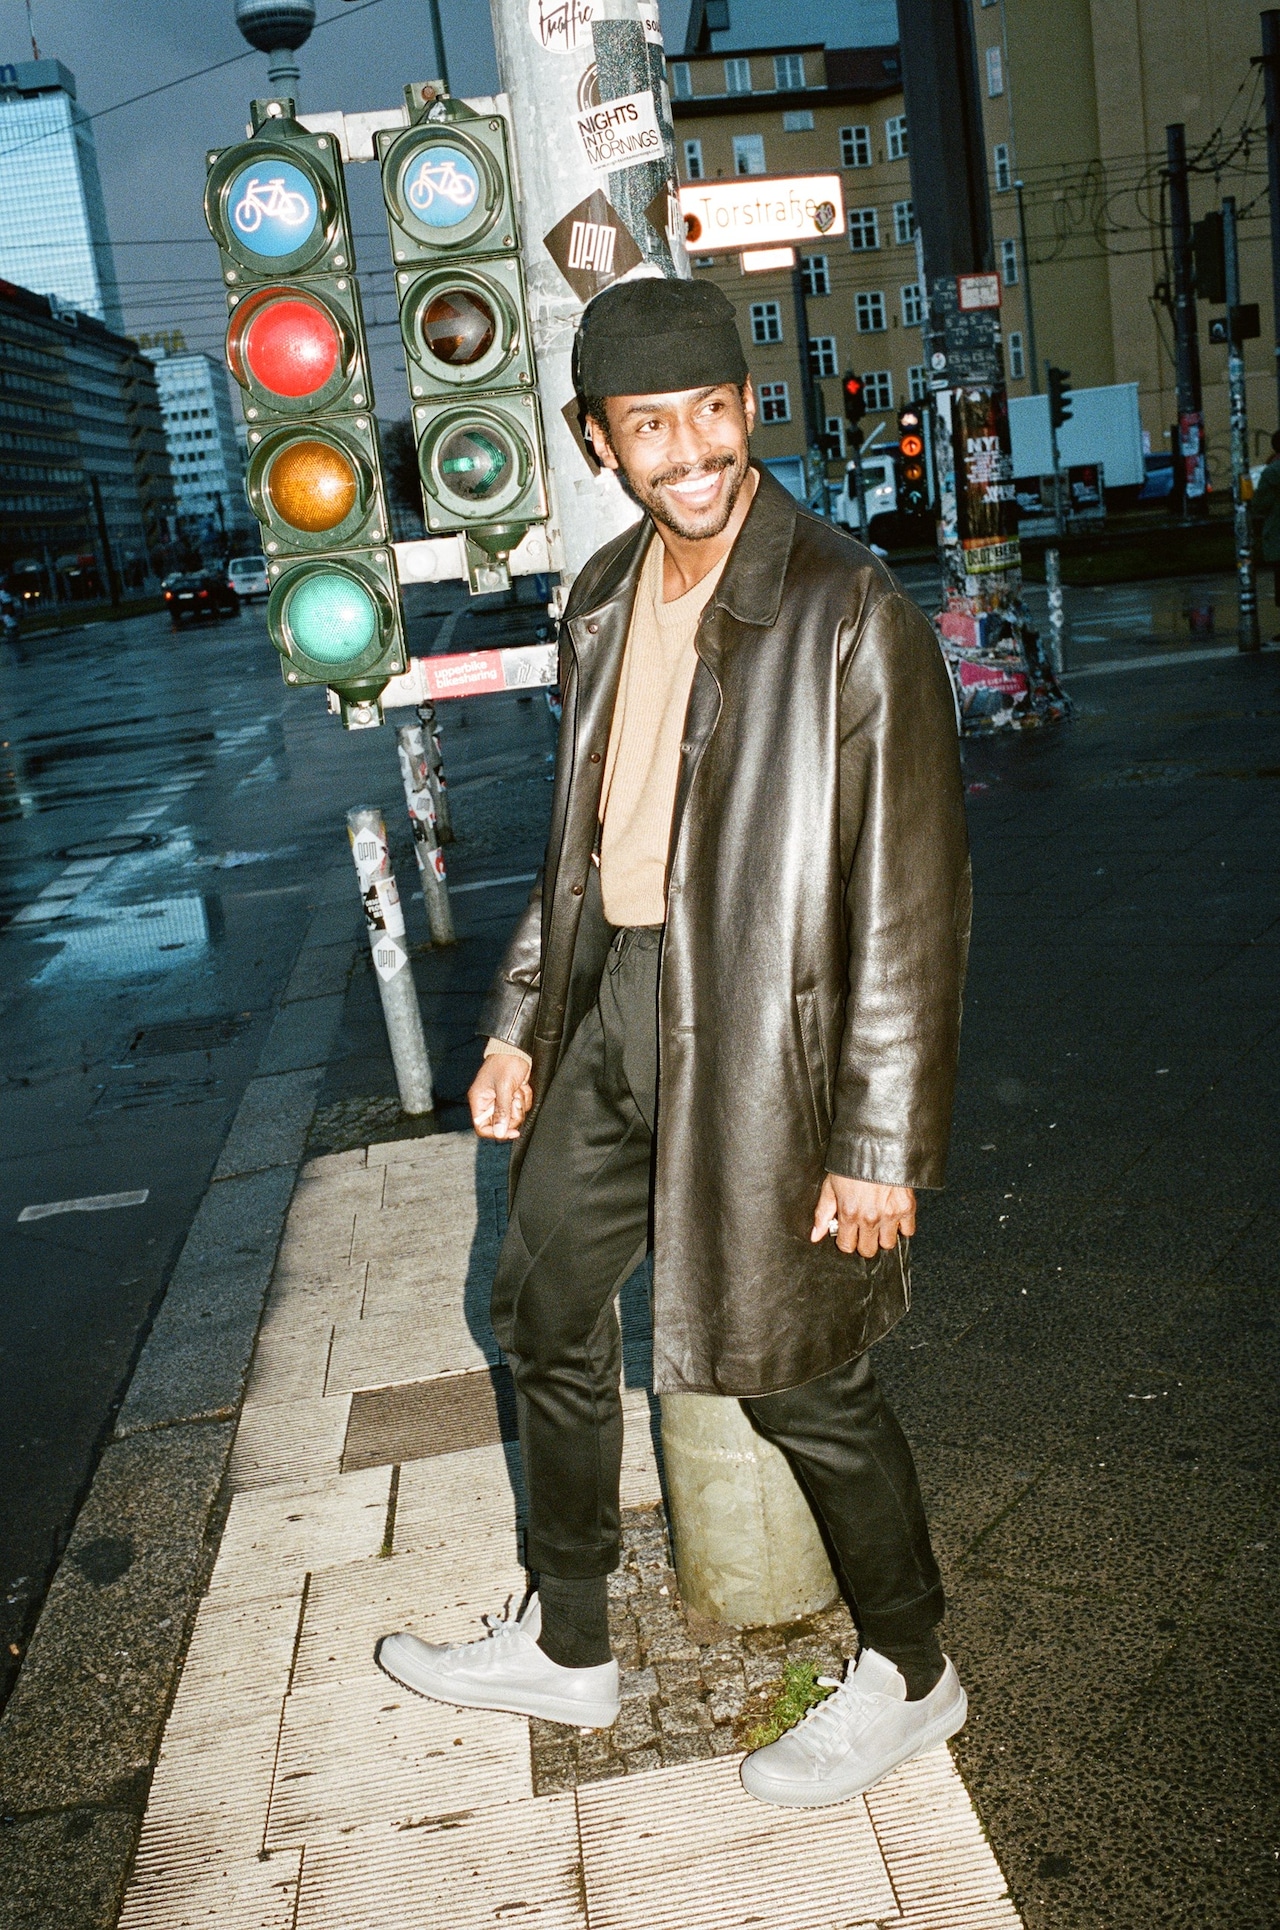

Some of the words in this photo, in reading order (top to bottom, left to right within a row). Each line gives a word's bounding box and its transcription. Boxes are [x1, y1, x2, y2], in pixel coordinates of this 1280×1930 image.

[577, 103, 639, 137] NIGHTS
[582, 129, 615, 149] INTO
[586, 129, 659, 164] MORNINGS
[699, 189, 816, 229] Torstraße
[434, 660, 488, 679] upperbike
[436, 669, 498, 689] bikesharing
